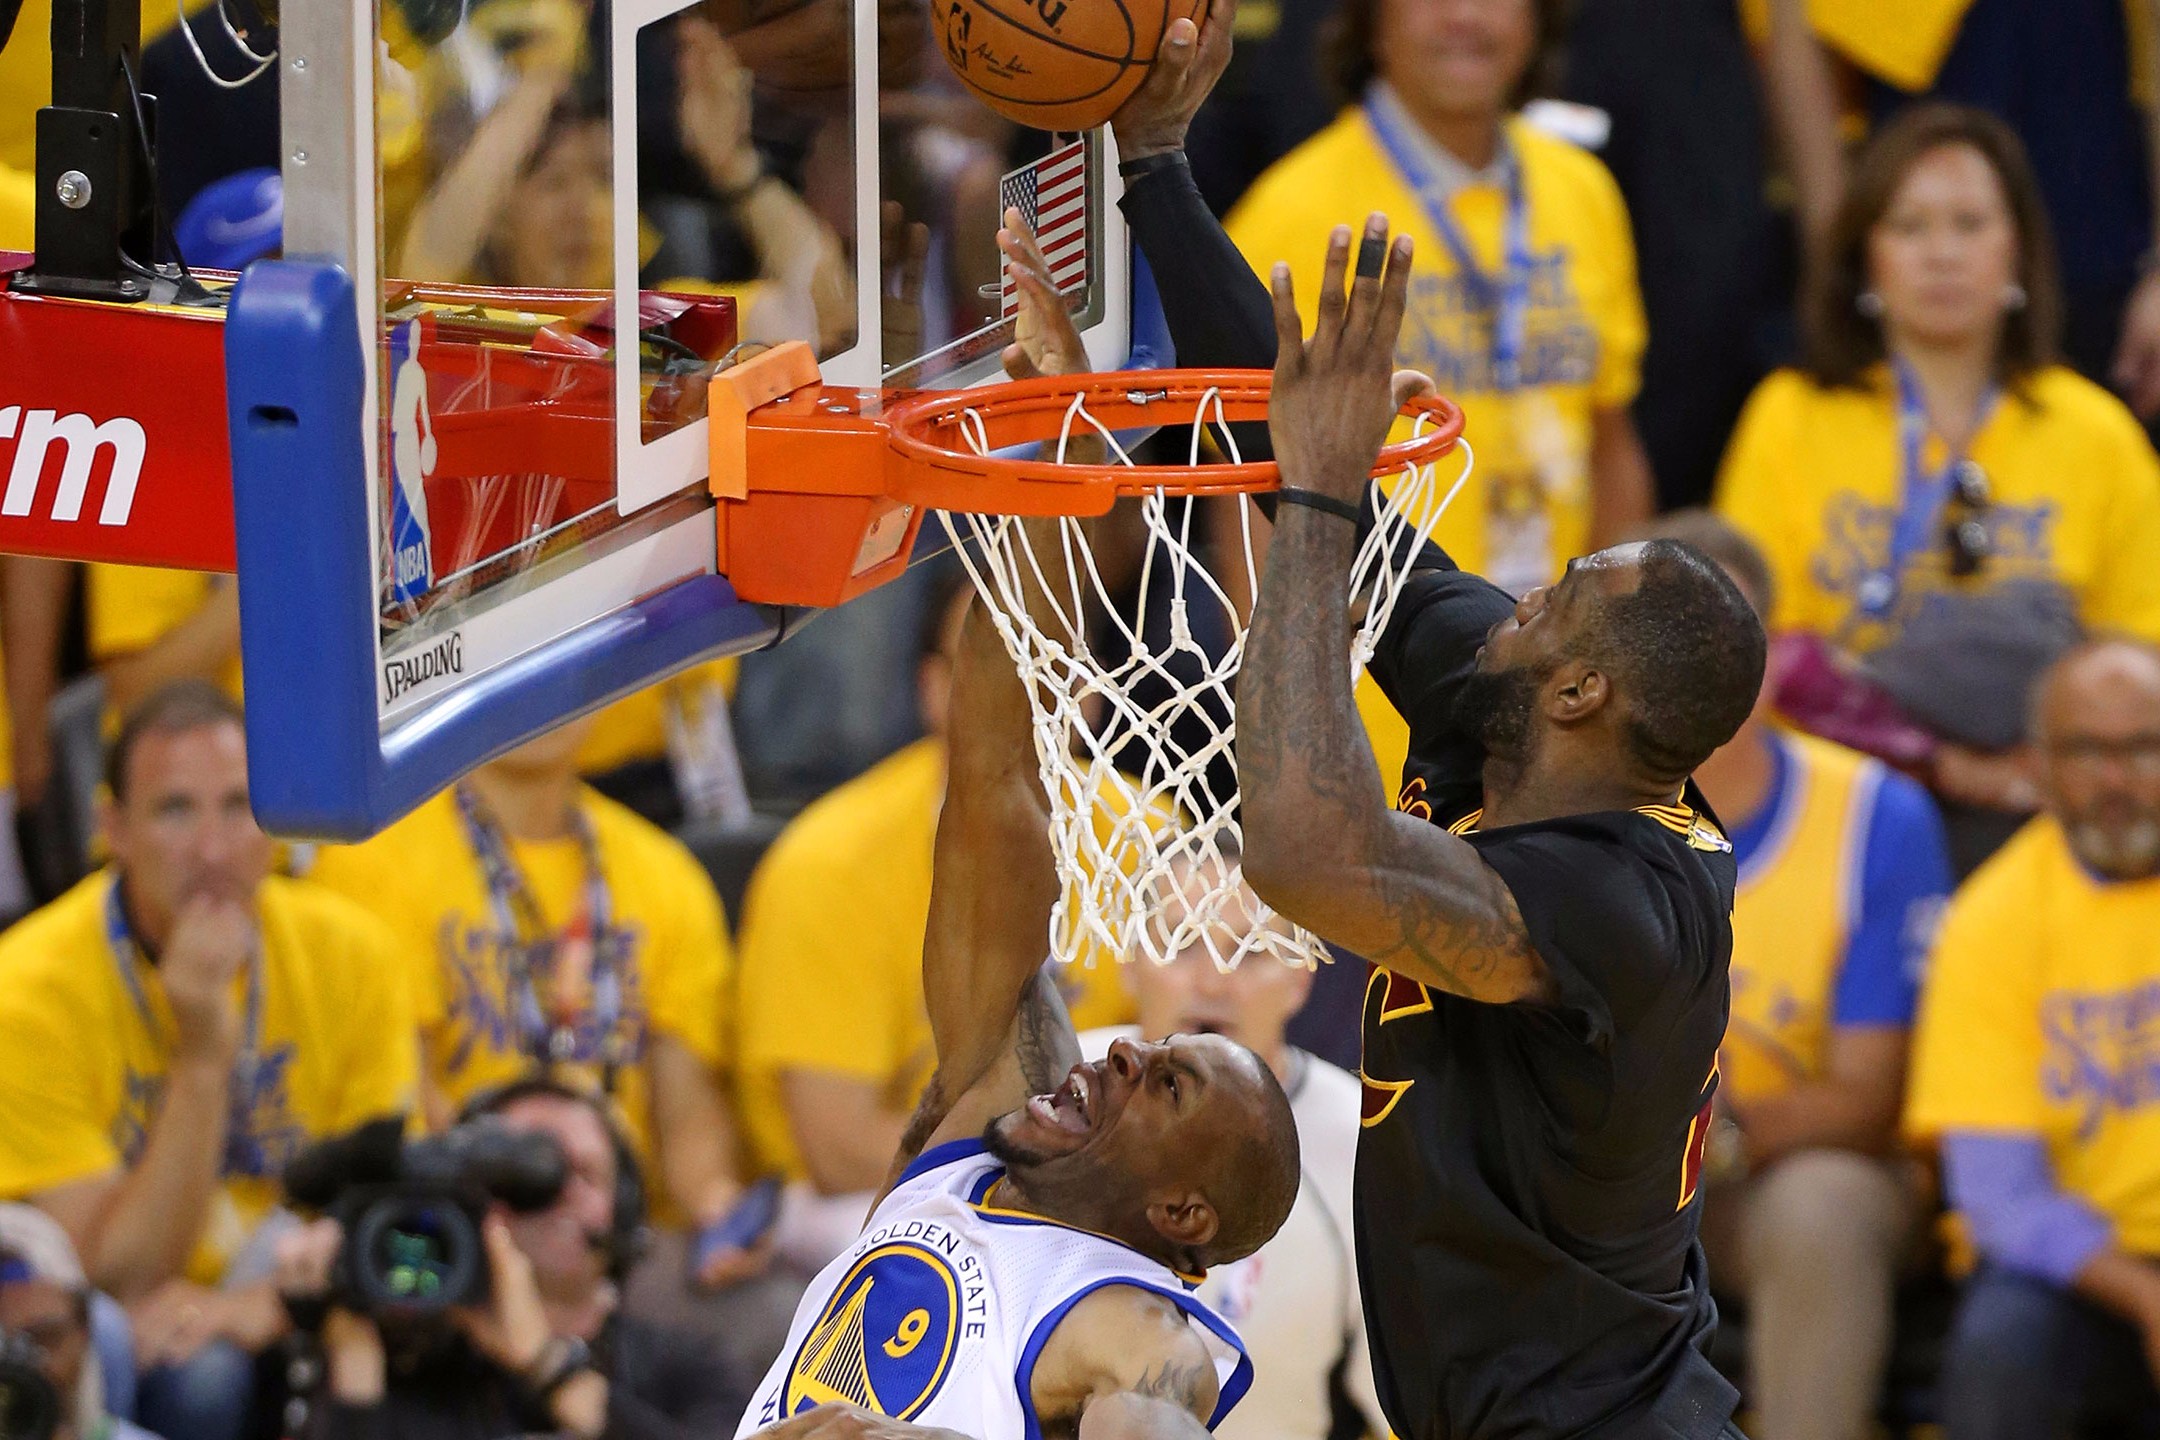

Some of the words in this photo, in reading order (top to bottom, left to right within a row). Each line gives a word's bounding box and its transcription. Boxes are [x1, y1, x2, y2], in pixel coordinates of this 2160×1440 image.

[398, 541, 426, 585] NBA
[384, 631, 462, 704] SPALDING
[959, 1256, 986, 1339] STATE
[882, 1307, 931, 1358] 9
